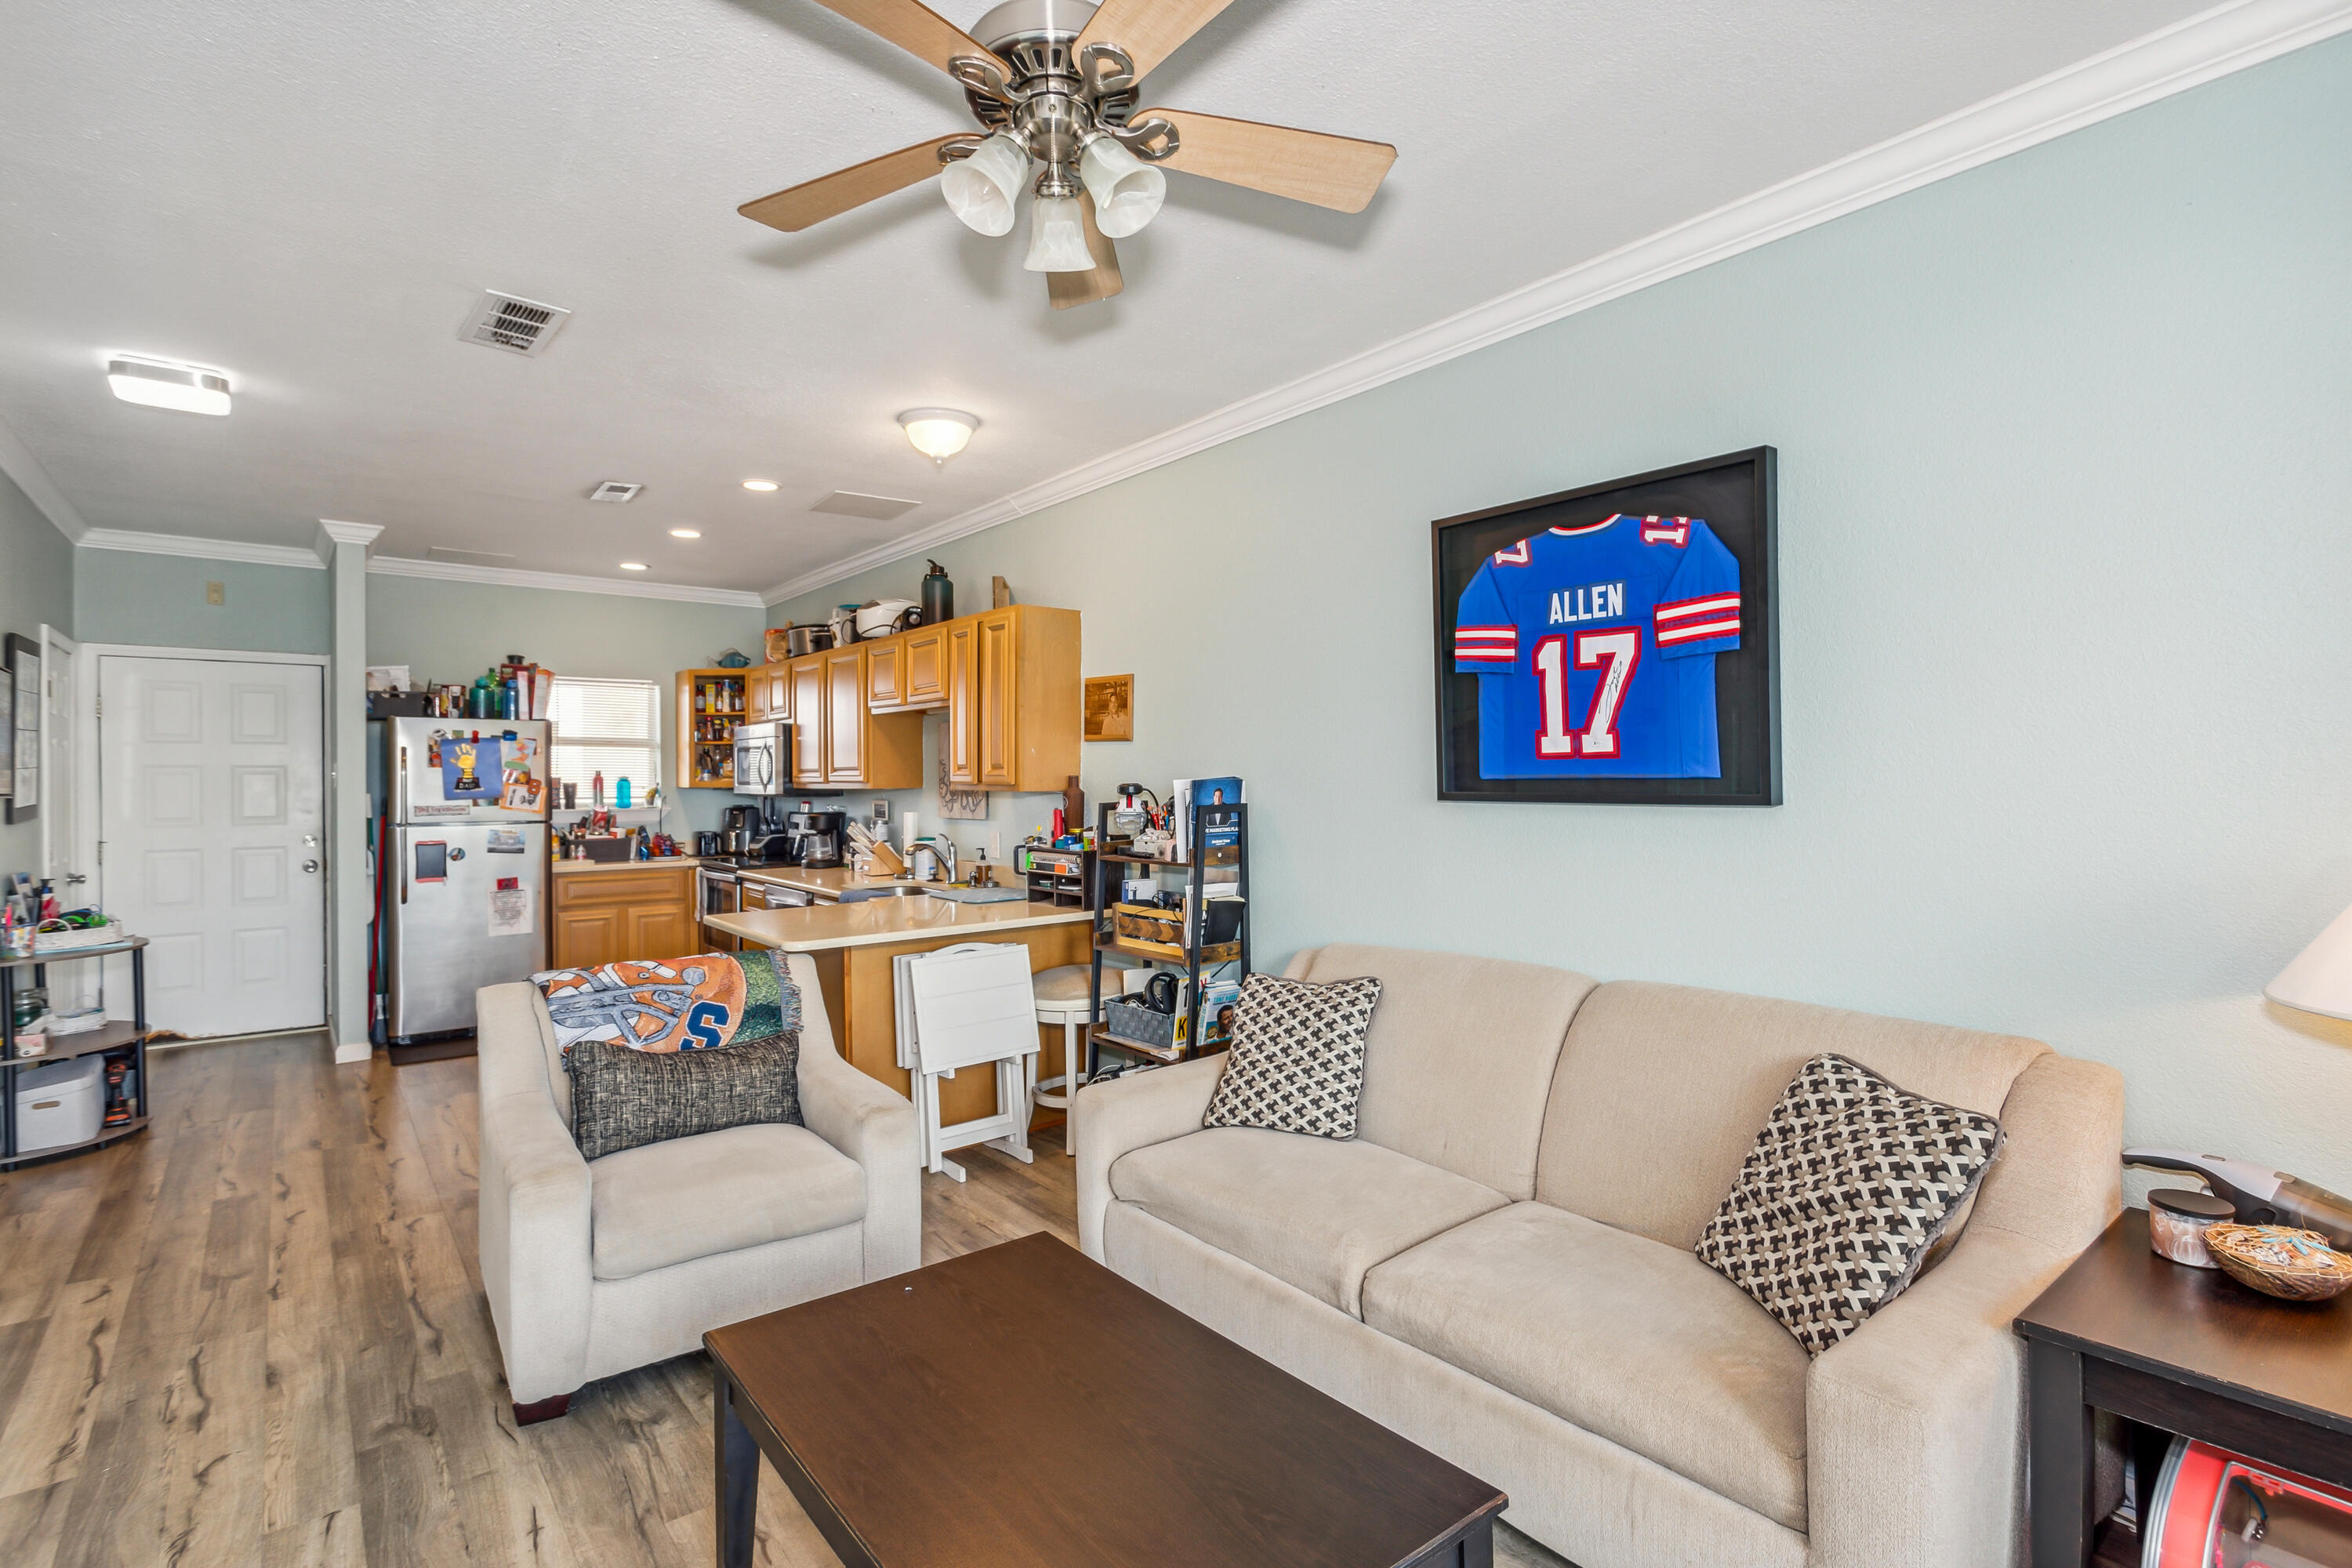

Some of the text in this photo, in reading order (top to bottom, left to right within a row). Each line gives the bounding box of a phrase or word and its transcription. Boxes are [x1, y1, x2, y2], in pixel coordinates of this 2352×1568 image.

[1549, 583, 1623, 625] ALLEN
[1534, 628, 1639, 757] 17
[680, 1000, 731, 1052] S
